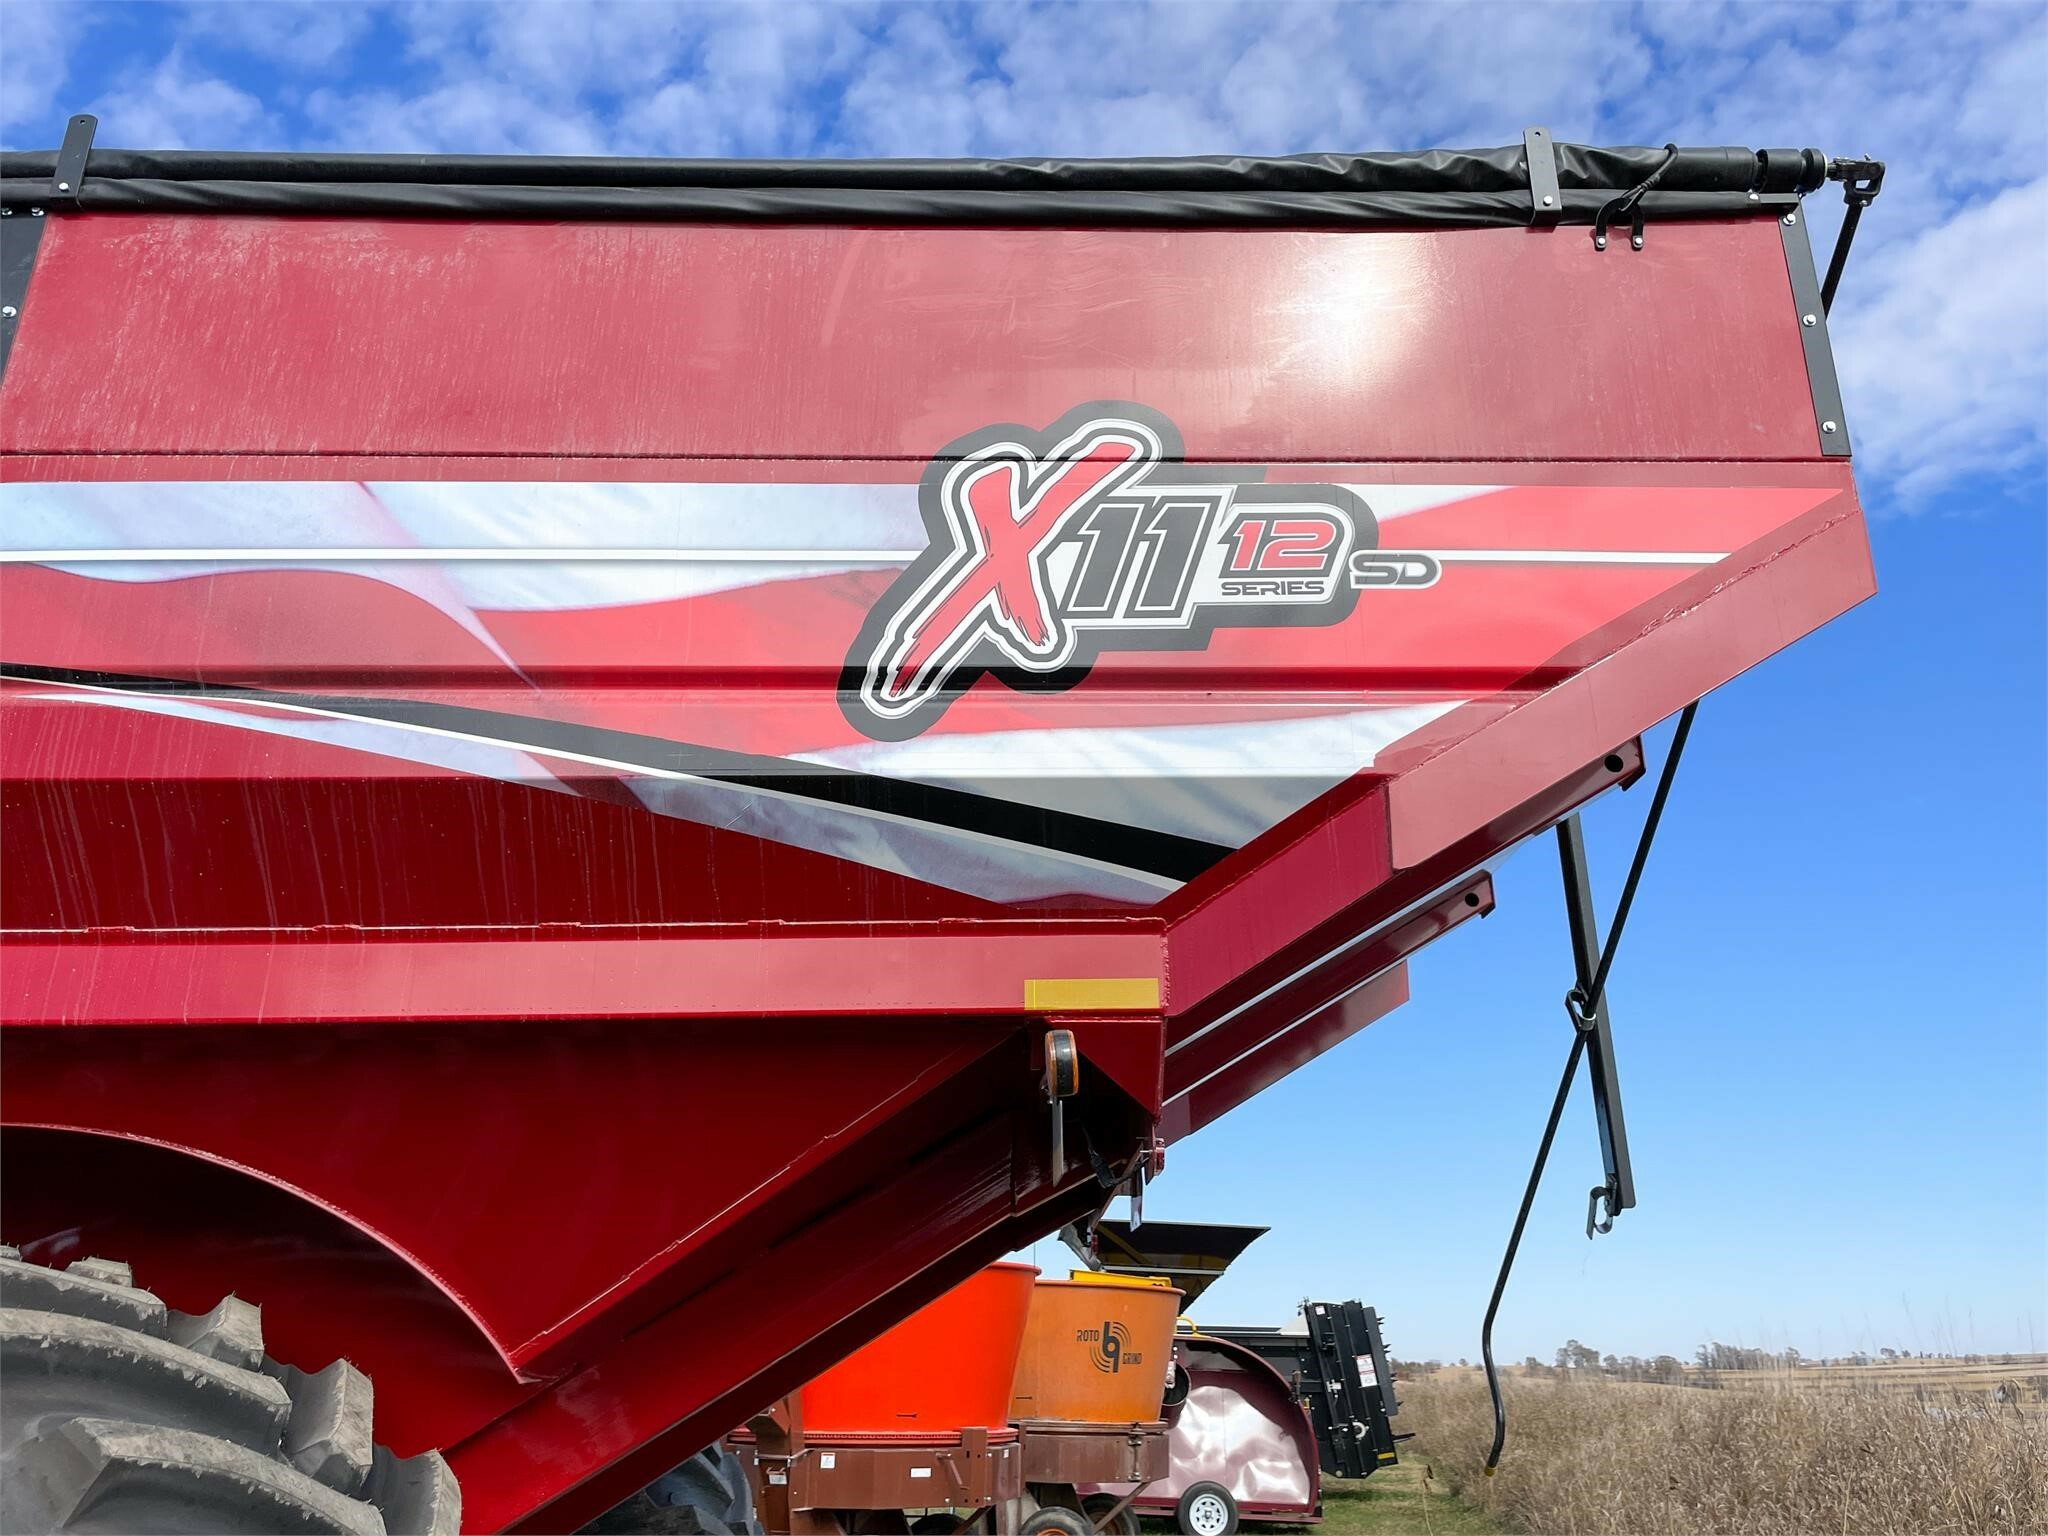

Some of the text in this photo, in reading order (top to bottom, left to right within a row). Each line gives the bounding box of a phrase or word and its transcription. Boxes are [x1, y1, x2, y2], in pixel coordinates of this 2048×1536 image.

[1230, 519, 1337, 571] 12
[1353, 553, 1438, 585] SD
[1221, 580, 1325, 596] SERIES
[1076, 1329, 1100, 1342] ROTO
